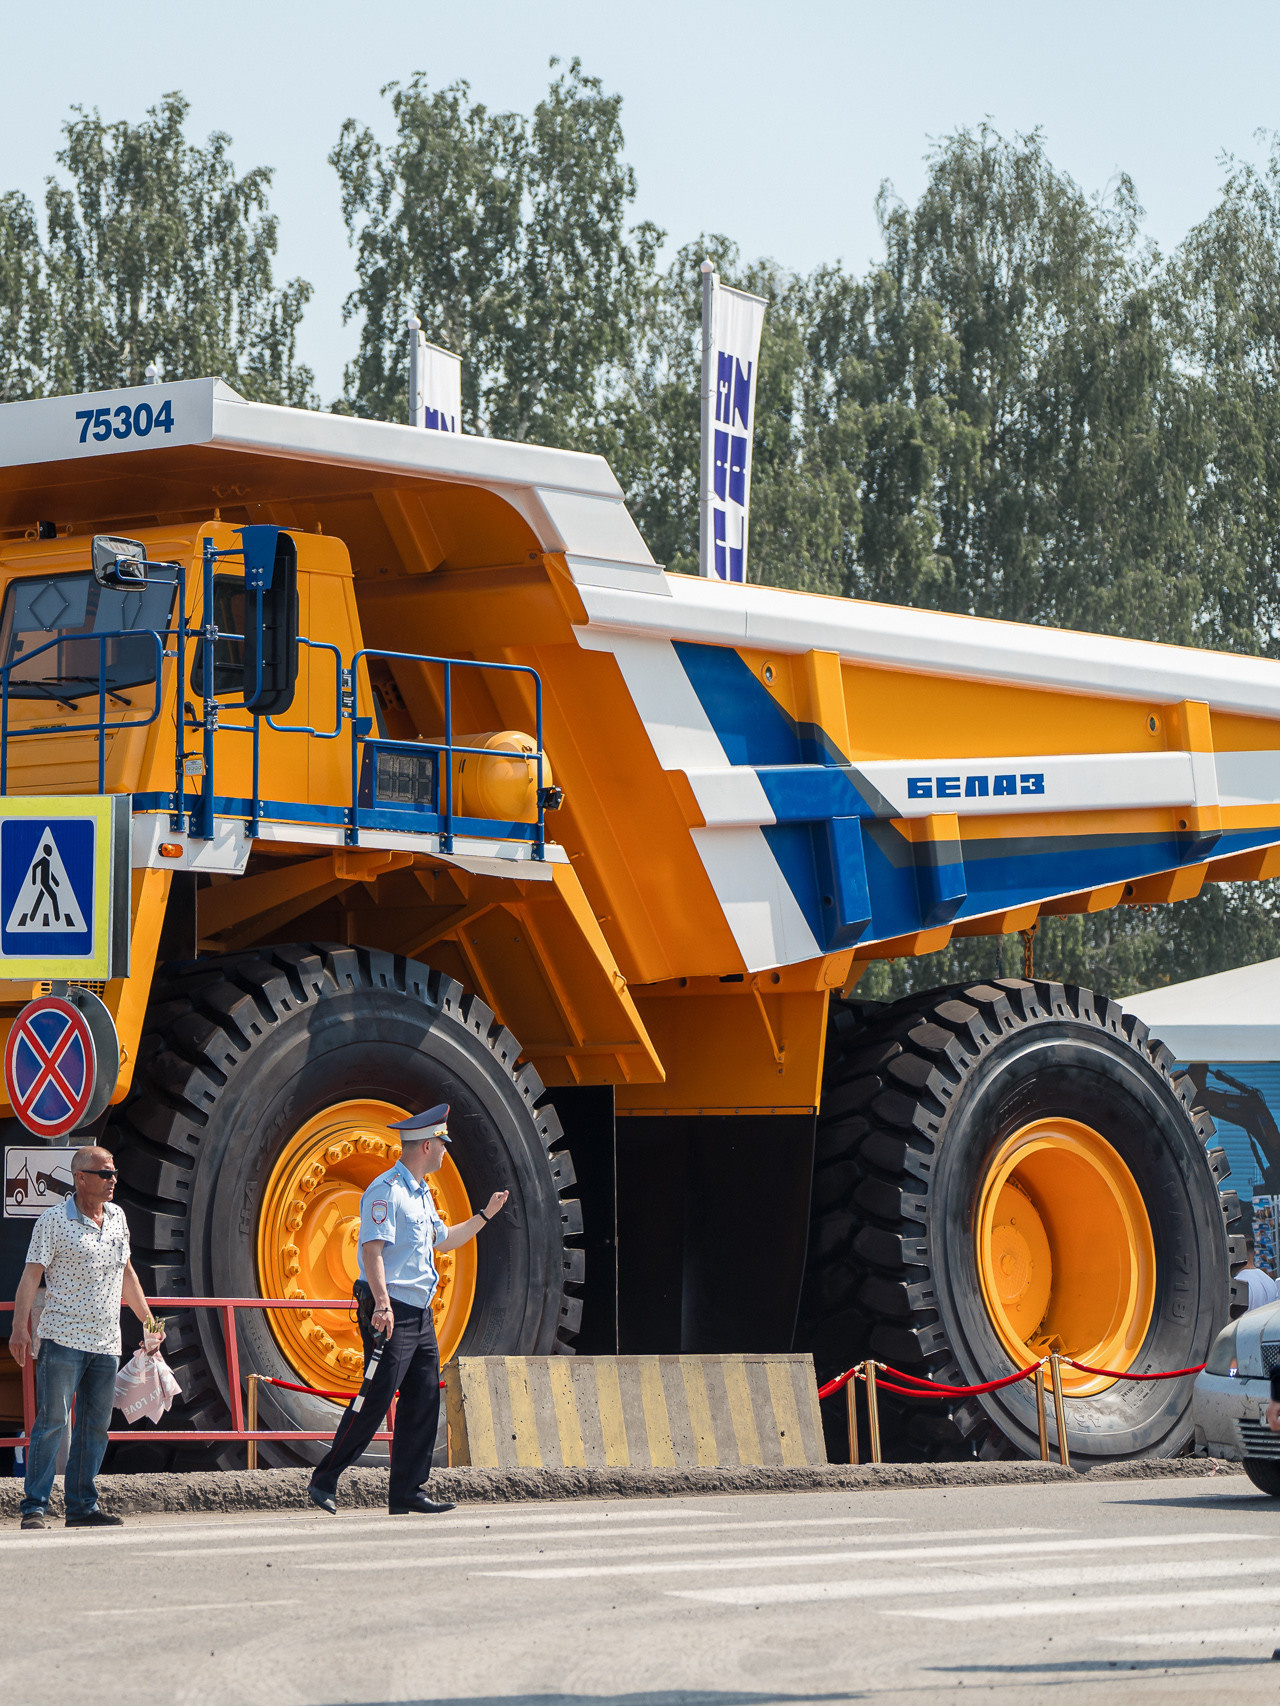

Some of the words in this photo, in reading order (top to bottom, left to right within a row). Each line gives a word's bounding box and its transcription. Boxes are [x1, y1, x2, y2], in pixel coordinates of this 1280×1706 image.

[76, 400, 174, 443] 75304
[907, 773, 1045, 799] БЕЛАЗ
[124, 1397, 148, 1416] LOVE
